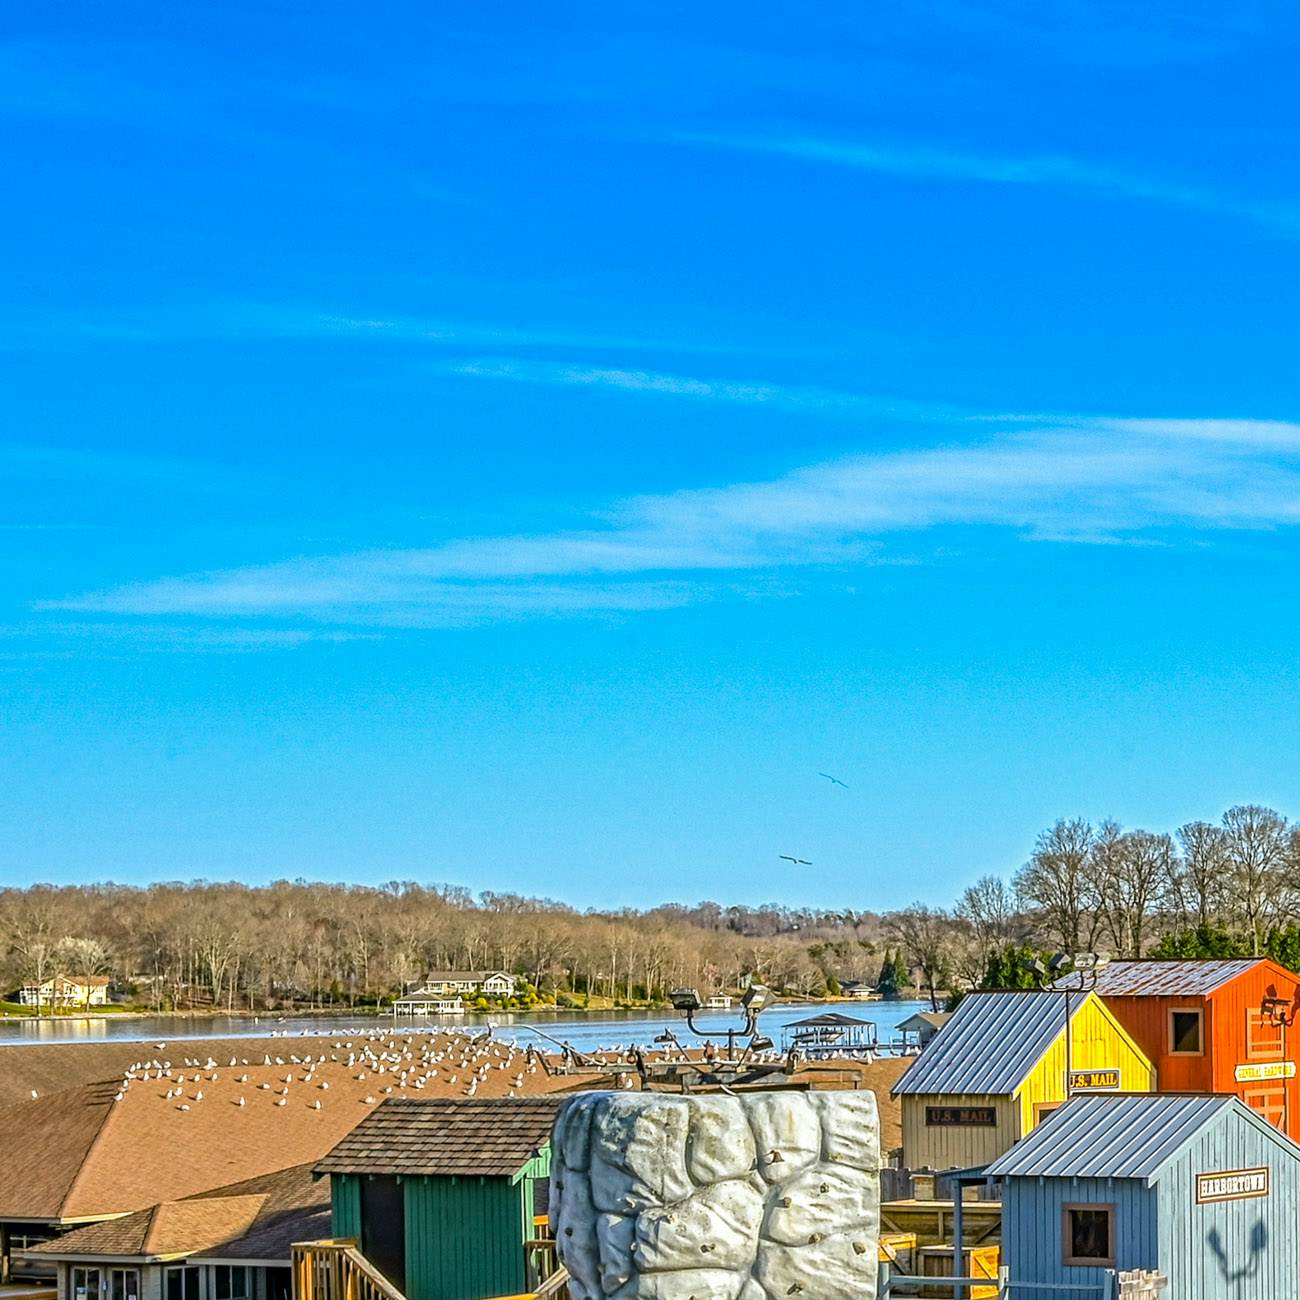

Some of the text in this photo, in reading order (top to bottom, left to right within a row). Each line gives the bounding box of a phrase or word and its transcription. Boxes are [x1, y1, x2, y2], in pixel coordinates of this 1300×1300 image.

[1090, 1073, 1117, 1086] MAIL
[931, 1111, 991, 1122] U.S. MAIL
[1200, 1173, 1265, 1197] HARBORTOWN
